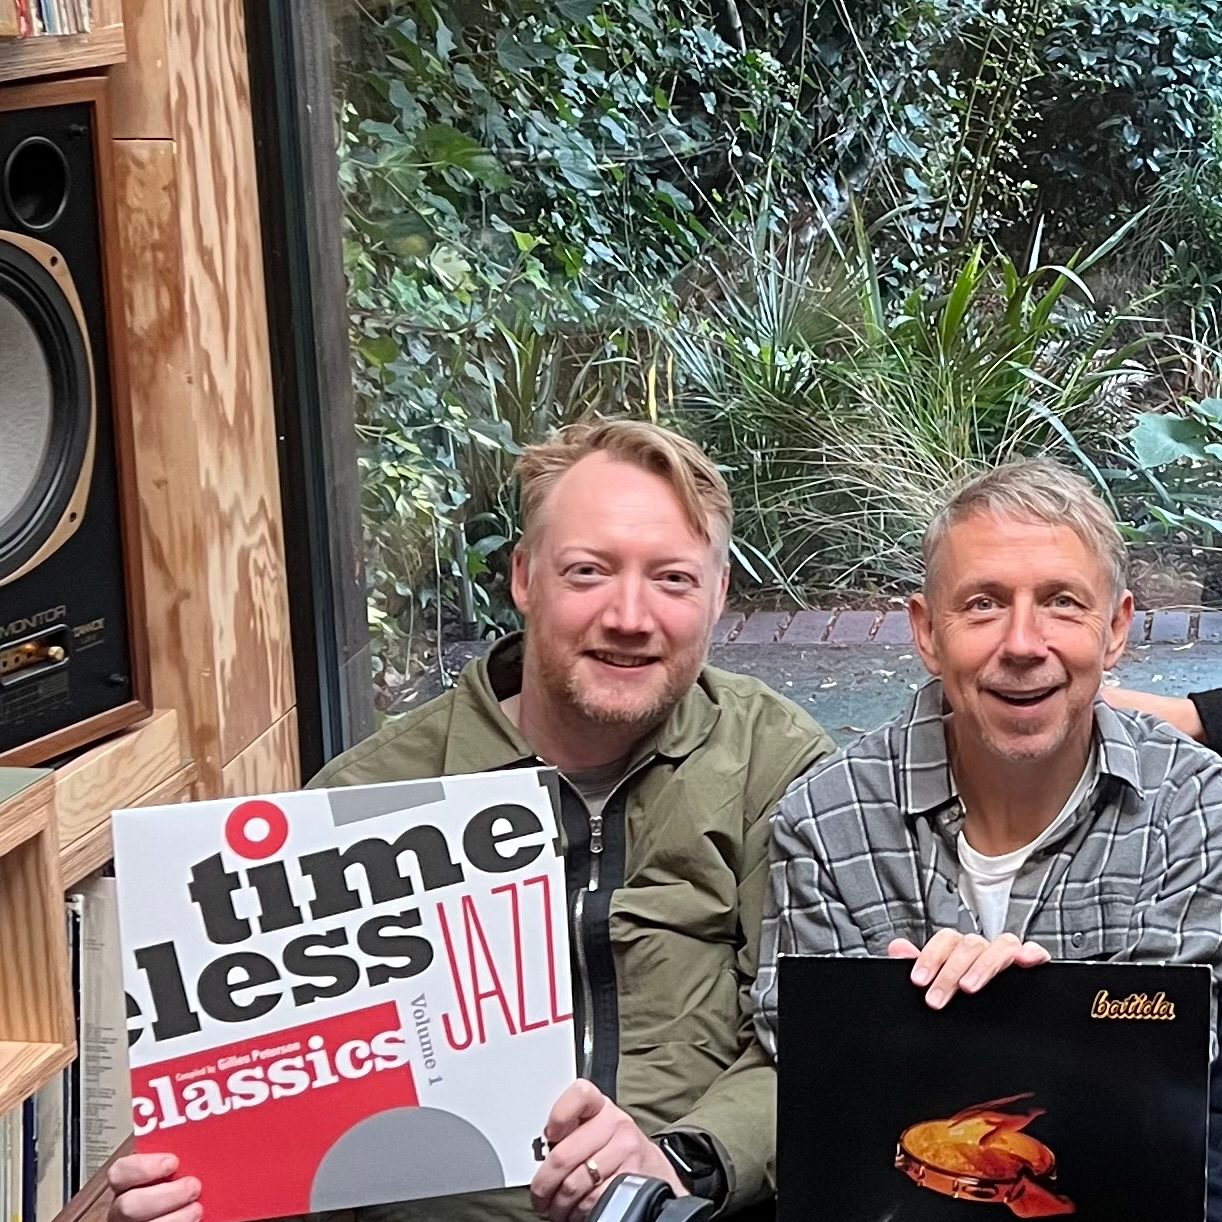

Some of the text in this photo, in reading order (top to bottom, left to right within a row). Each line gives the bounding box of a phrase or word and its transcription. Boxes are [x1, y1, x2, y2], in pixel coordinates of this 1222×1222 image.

[436, 875, 573, 1051] JAZZ
[1090, 989, 1176, 1020] batida
[131, 1035, 411, 1137] classics
[410, 993, 444, 1087] Volume 1
